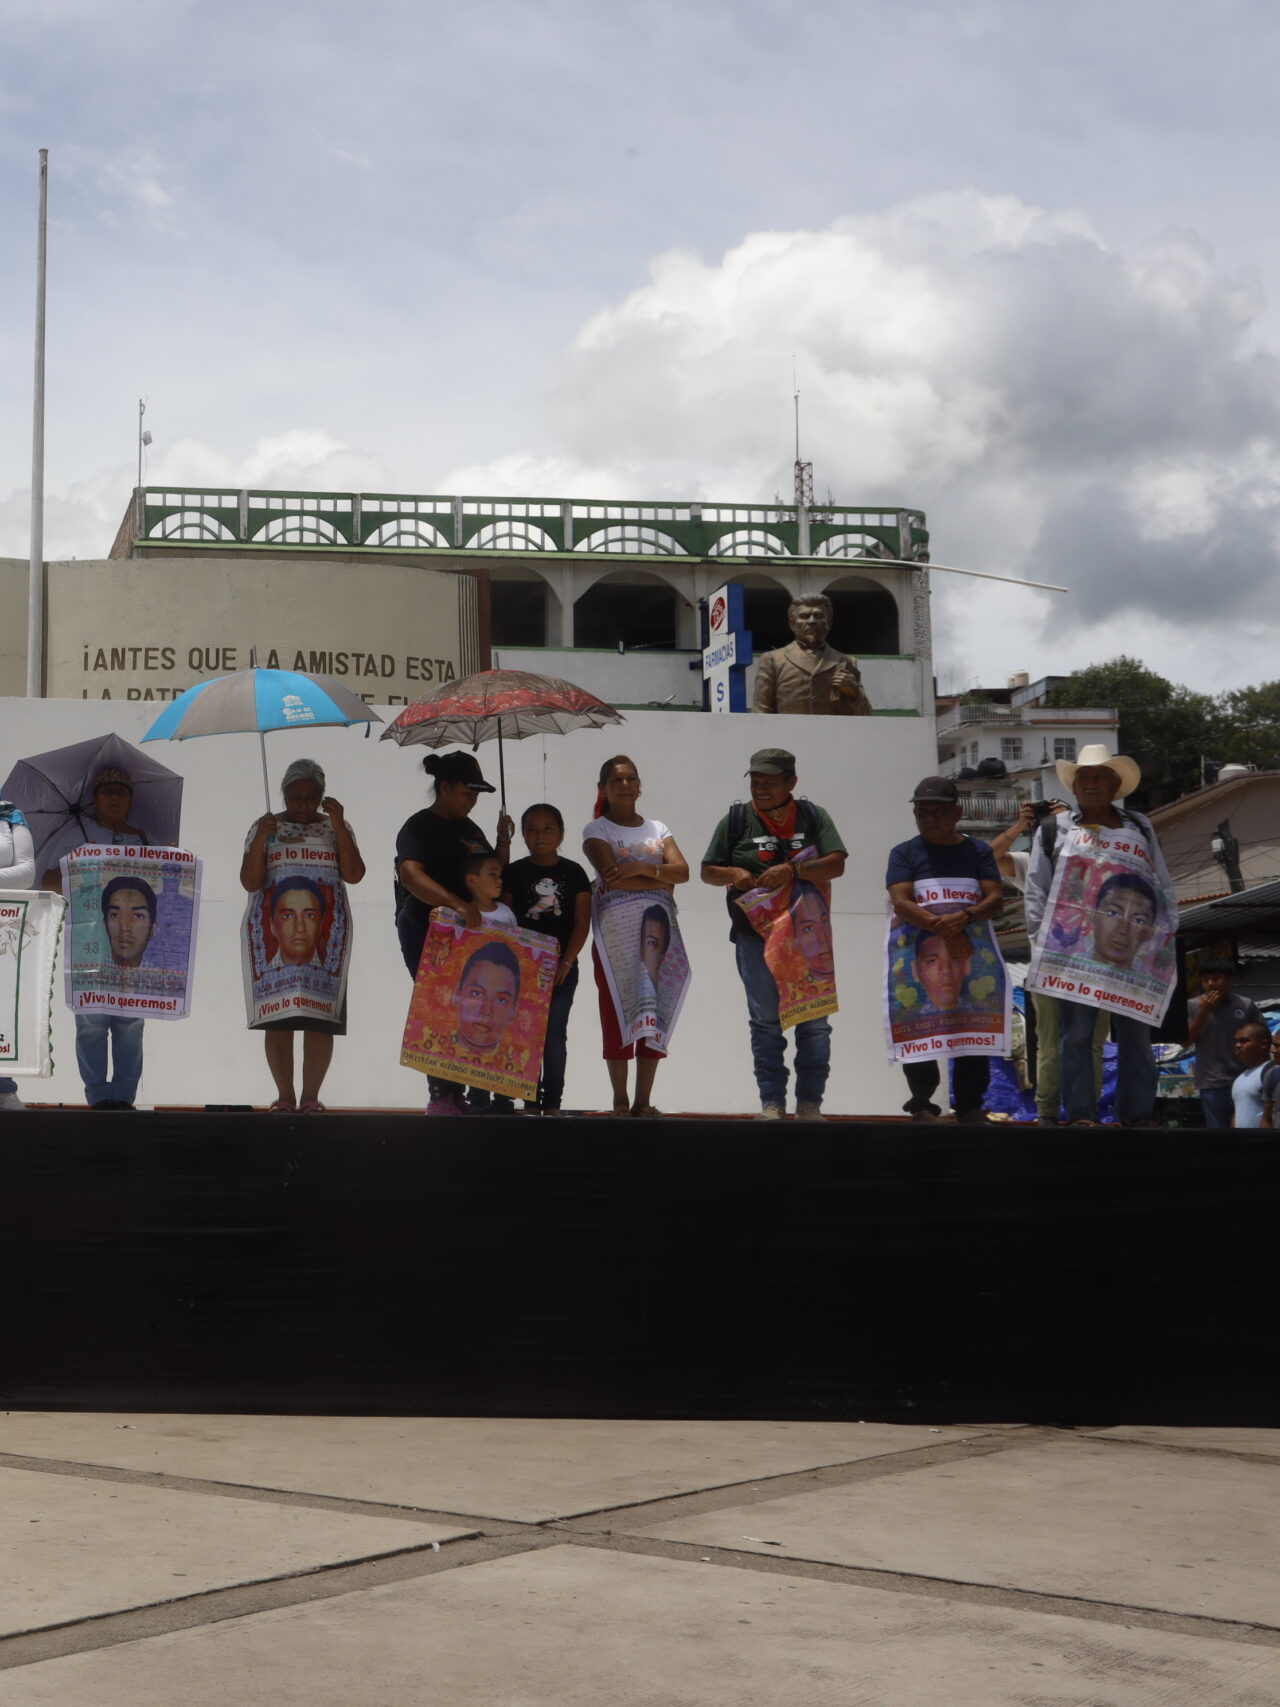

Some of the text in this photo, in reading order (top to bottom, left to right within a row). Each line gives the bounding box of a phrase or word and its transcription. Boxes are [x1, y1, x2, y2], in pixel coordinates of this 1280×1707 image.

[706, 641, 734, 669] FARMACIAS
[188, 648, 237, 674] QUE
[292, 651, 396, 678] AMISTAD
[406, 657, 456, 682] ESTA
[70, 846, 194, 862] ¡Vivo se lo llevaron!
[269, 847, 337, 863] se lo llevar
[1114, 841, 1130, 852] se
[1133, 844, 1145, 857] lo
[926, 890, 938, 901] lo
[108, 993, 115, 1005] lo
[1042, 975, 1155, 1015] ¡Vivo lo queremos!
[259, 997, 332, 1019] ¡Vivo lo queremos!
[646, 1015, 656, 1027] lo
[901, 1042, 928, 1057] ¡Vivo
[931, 1038, 942, 1049] lo
